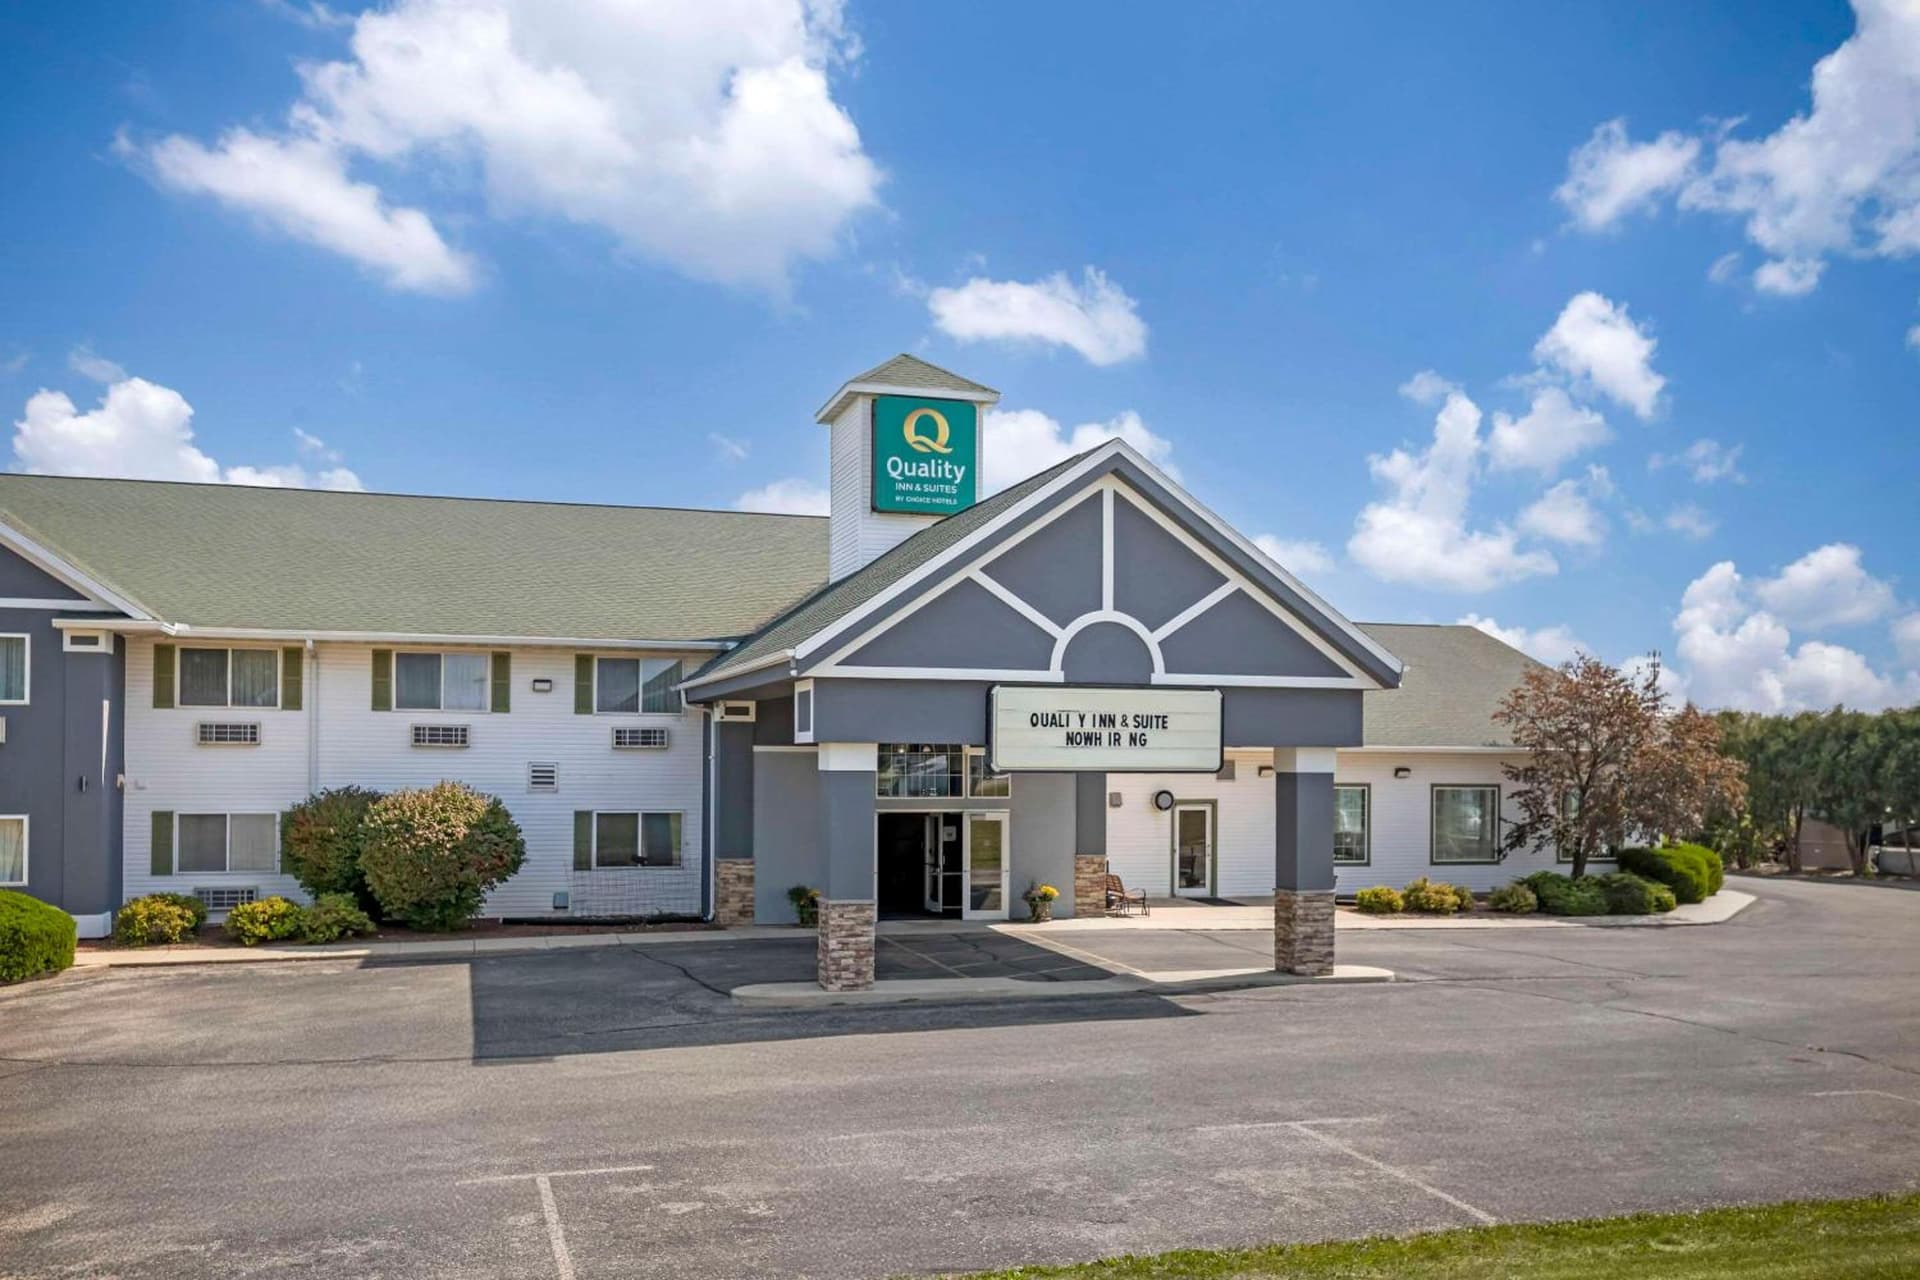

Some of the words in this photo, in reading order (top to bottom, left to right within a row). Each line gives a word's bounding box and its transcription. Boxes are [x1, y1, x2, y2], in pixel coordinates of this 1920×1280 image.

[903, 408, 953, 454] Q
[886, 456, 966, 484] Quality
[895, 482, 913, 491] INN
[914, 483, 922, 491] &
[922, 484, 958, 494] SUITES
[1092, 713, 1116, 729] INN
[1120, 714, 1129, 728] &
[1132, 714, 1168, 730] SUITE
